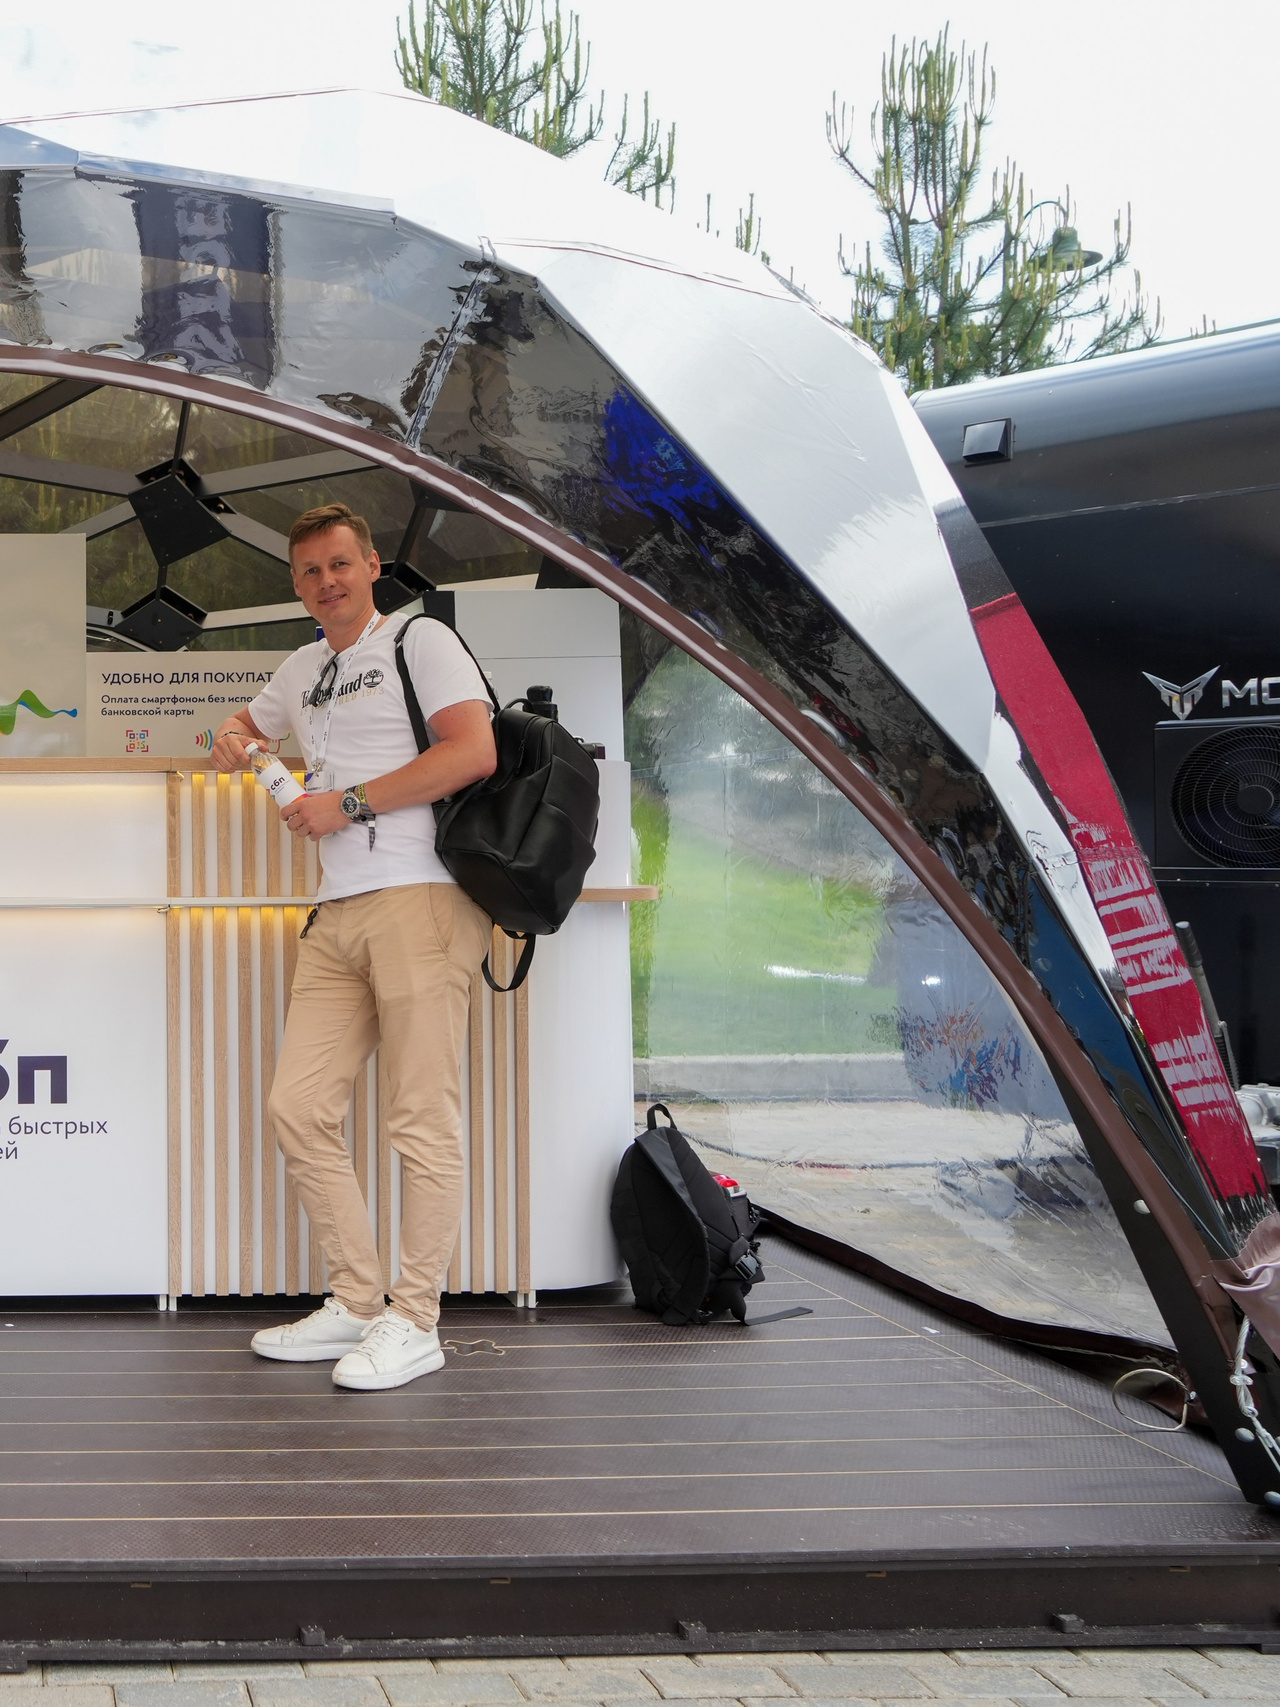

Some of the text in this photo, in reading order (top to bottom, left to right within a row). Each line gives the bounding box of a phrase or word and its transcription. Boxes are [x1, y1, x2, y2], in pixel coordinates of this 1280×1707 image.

[101, 672, 164, 685] УДОБНО
[169, 672, 199, 685] ДЛЯ
[361, 686, 385, 698] 1973
[101, 695, 139, 704] Оплата
[141, 695, 206, 705] смартфоном
[208, 694, 225, 703] без
[101, 707, 194, 717] банковской карты
[270, 775, 286, 791] сбп
[8, 1115, 108, 1140] быстрых
